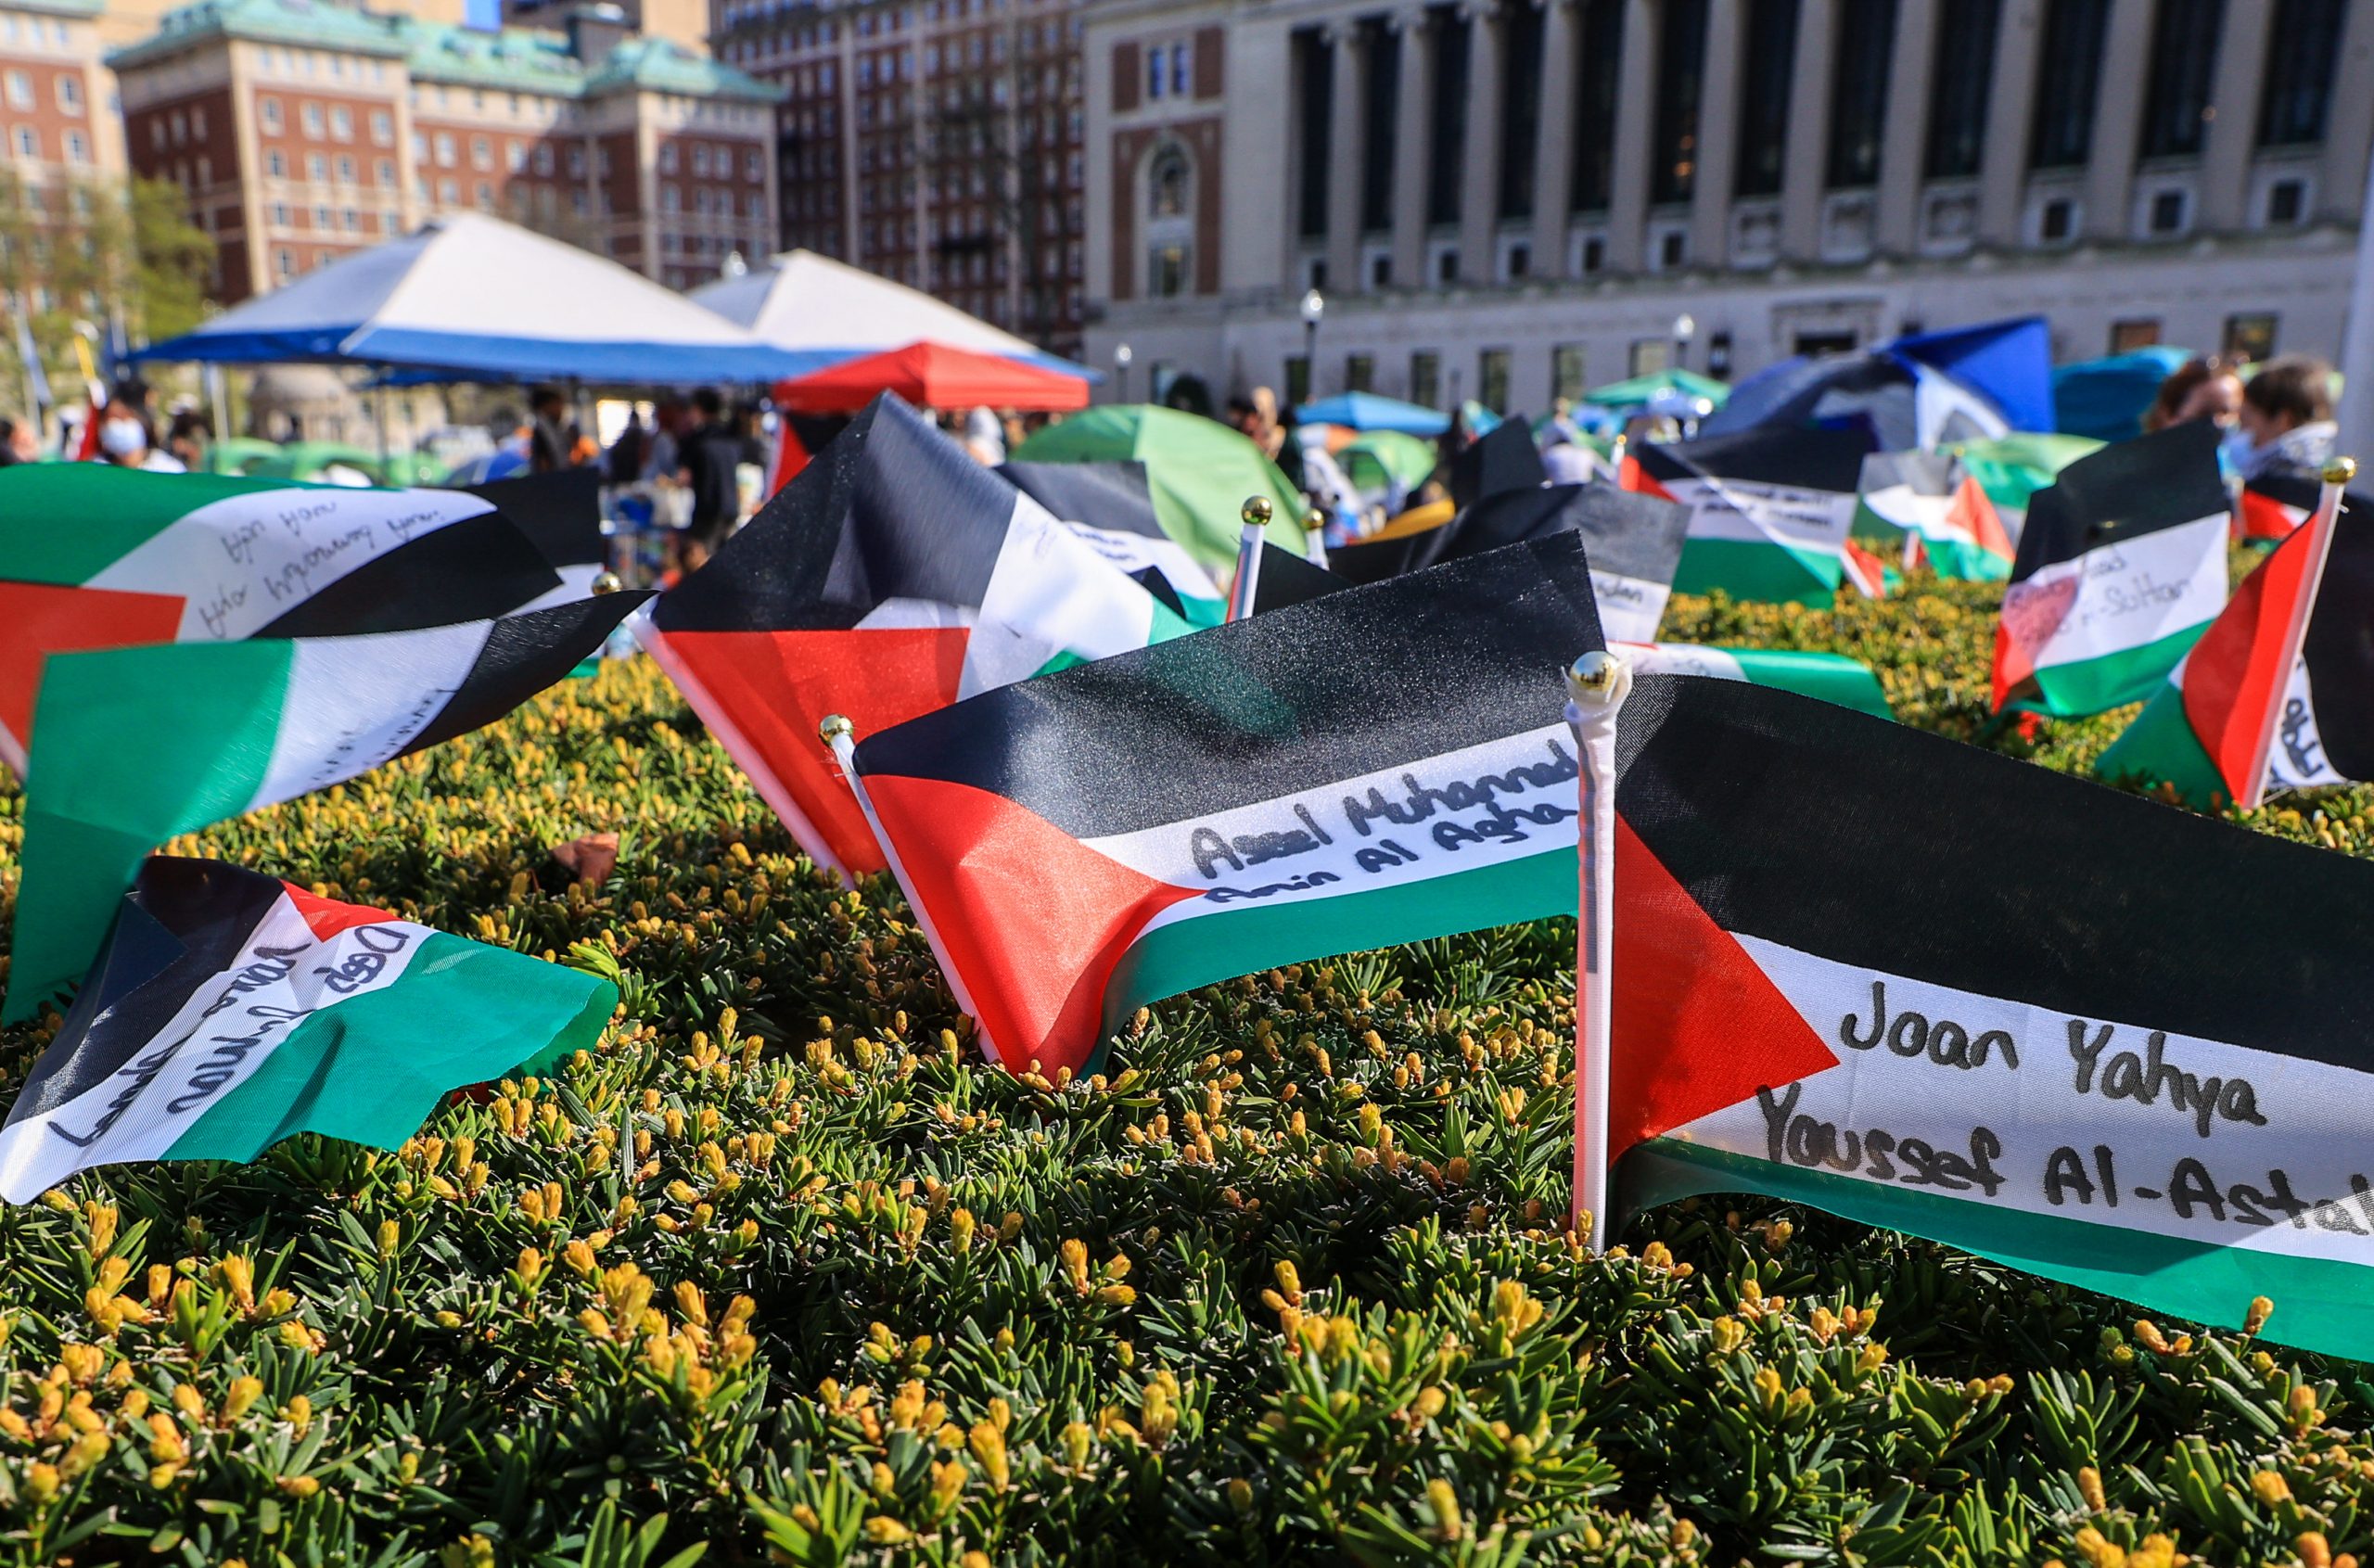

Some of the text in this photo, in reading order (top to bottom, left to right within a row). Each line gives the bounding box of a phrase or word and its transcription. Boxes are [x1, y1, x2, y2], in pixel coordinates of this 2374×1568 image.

[1354, 838, 1419, 873] Al
[1432, 800, 1578, 852] Agha
[1841, 981, 2268, 1137] Joan Yahya
[1755, 1081, 2007, 1197] Youssef
